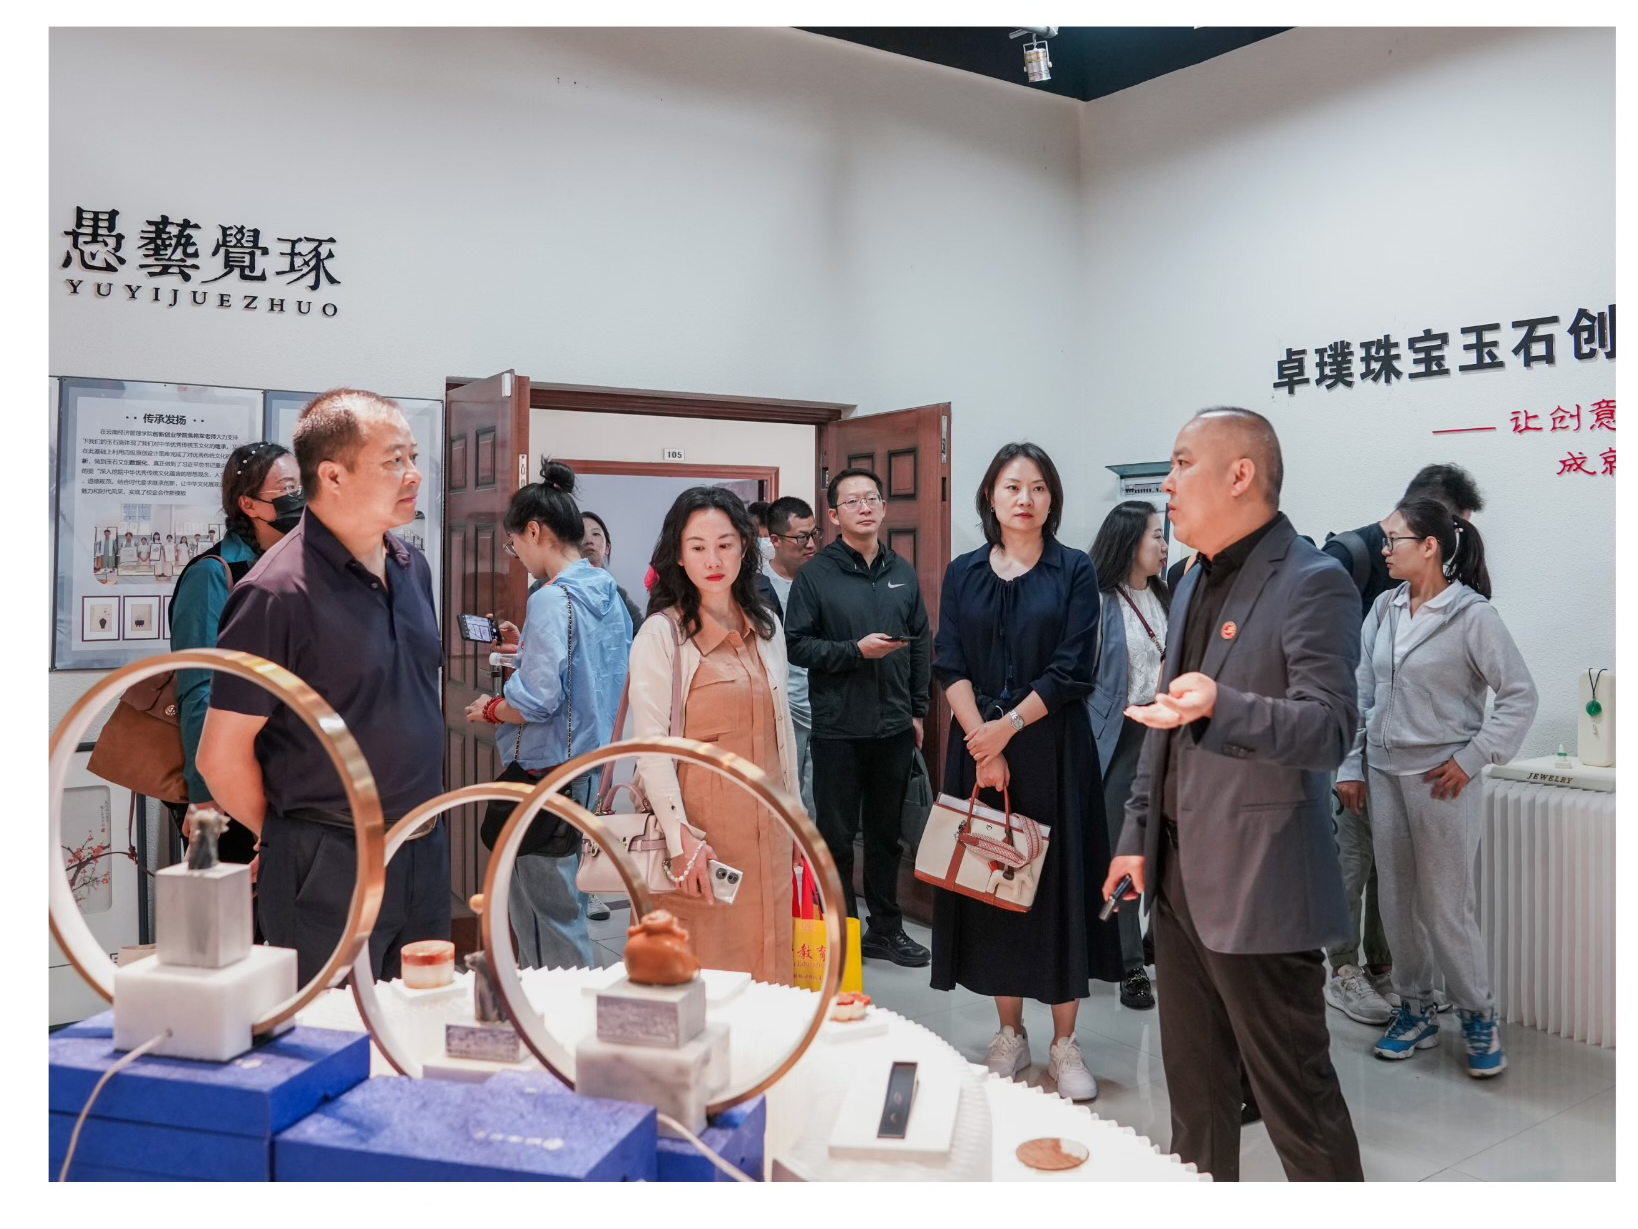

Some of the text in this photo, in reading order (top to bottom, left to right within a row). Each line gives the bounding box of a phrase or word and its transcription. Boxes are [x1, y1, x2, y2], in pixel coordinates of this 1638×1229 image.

[60, 204, 343, 291] 愚藝覺琢
[64, 278, 340, 318] YUYIJUEZHUO
[1272, 303, 1616, 396] 卓璞珠宝玉石创
[142, 413, 187, 426] 传承发扬
[666, 450, 684, 459] 105
[1526, 772, 1574, 784] JEWELRY
[796, 943, 828, 963] 教育
